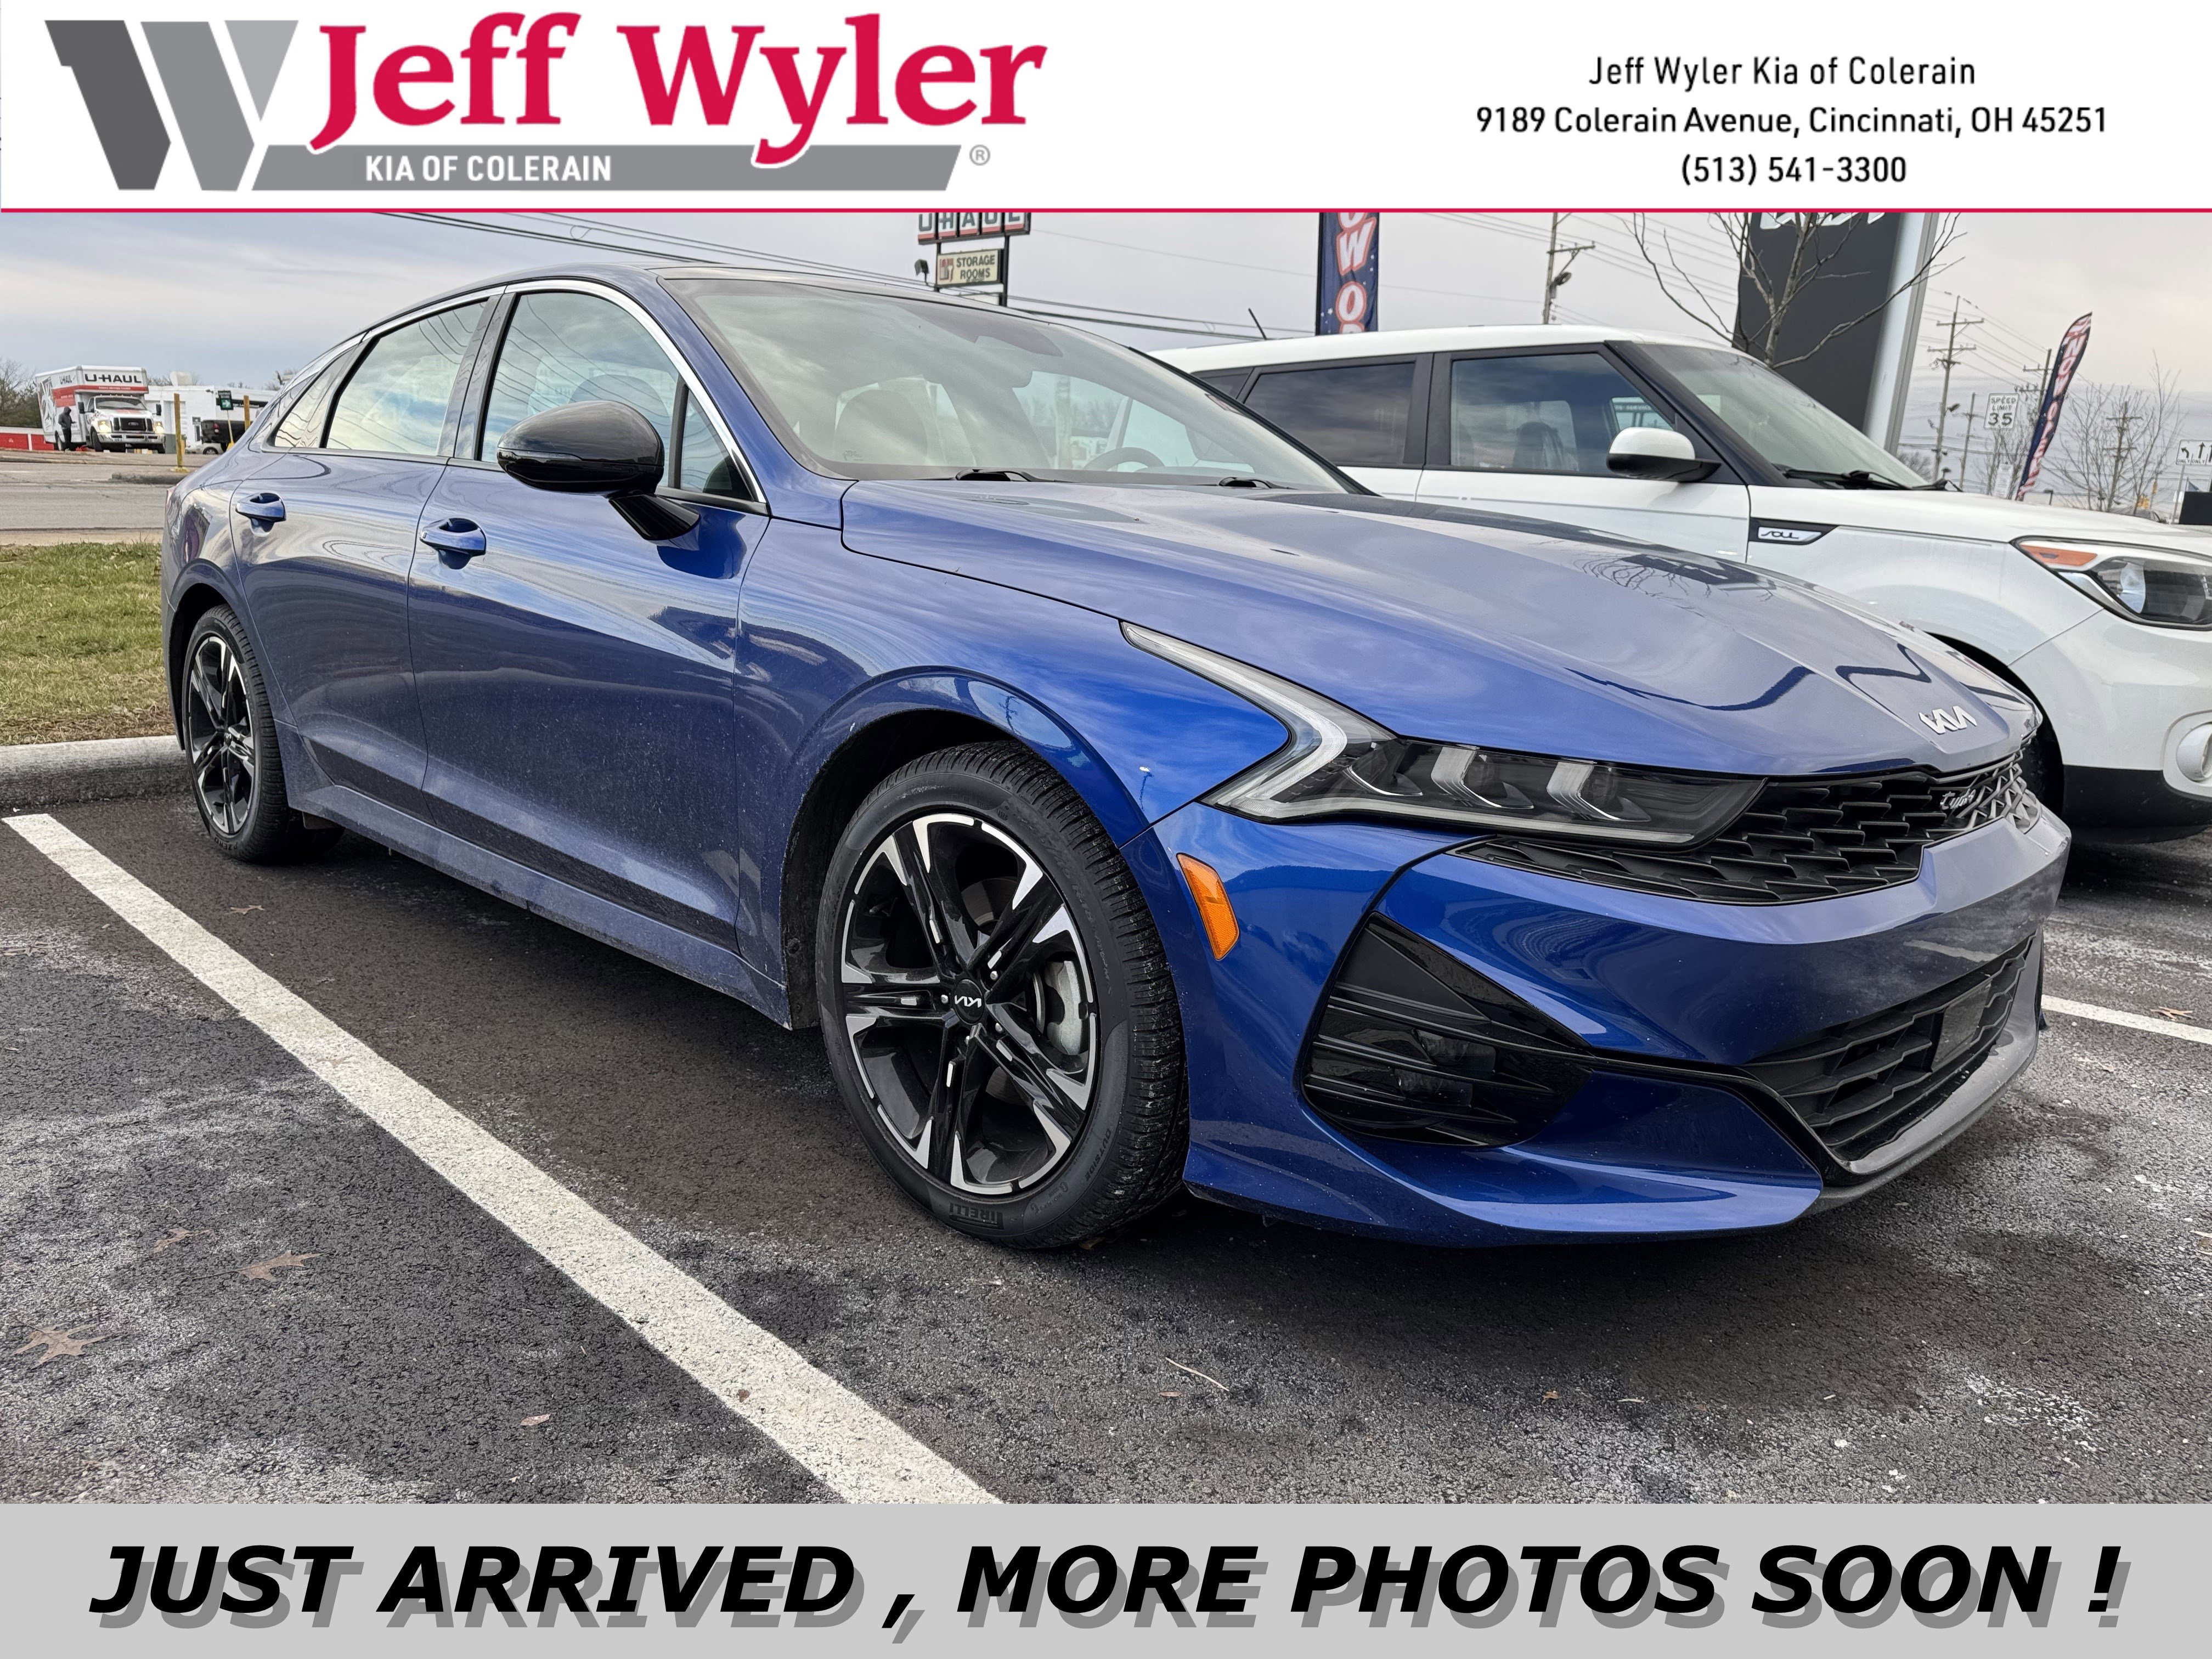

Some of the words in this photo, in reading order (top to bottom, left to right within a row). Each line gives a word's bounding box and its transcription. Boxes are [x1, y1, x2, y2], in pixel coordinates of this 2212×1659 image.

[956, 255, 996, 268] STORAGE
[960, 268, 991, 280] ROOMS
[84, 373, 142, 383] U-HAUL
[1988, 413, 2012, 426] 35
